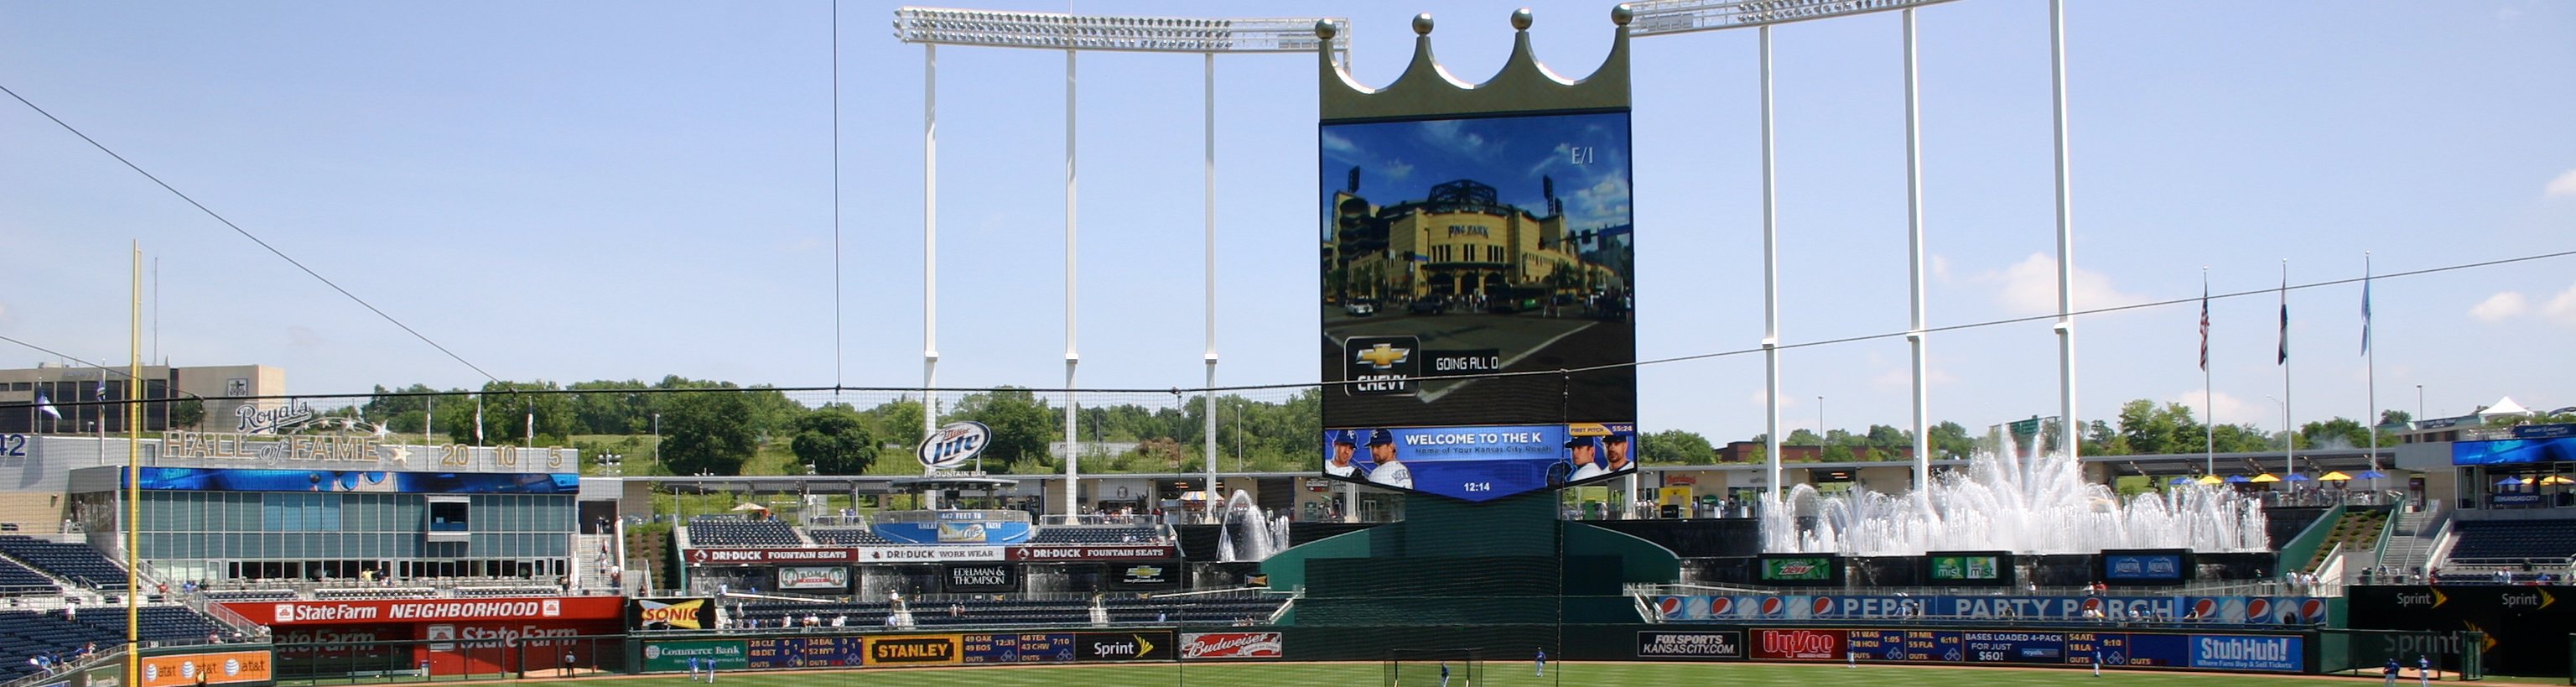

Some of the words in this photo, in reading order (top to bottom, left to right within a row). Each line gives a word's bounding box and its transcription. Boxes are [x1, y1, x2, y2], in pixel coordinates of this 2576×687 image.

[1436, 357, 1467, 371] GOING
[1469, 357, 1488, 370] ALL
[1357, 374, 1407, 392] CHEVY
[235, 398, 310, 434] Royals
[1405, 433, 1476, 445] WELCOME
[1478, 433, 1498, 444] TO
[1501, 432, 1529, 443] THE
[1532, 432, 1542, 443] K
[163, 430, 254, 459] HALL
[259, 437, 288, 466] of
[290, 435, 382, 462] FAME
[932, 434, 980, 465] Lite
[1506, 445, 1522, 454] City
[440, 444, 470, 467] 20
[493, 445, 518, 467] 10
[548, 445, 564, 468] 5
[1463, 482, 1491, 492] 12:14
[767, 551, 816, 559] FOUNTAIN
[818, 551, 847, 559] SEATS
[1087, 549, 1134, 557] FOUNTAIN
[1135, 549, 1164, 557] SEATS
[953, 567, 995, 576] EDELMAN
[995, 566, 1005, 576] &
[953, 575, 1005, 586] THOMPSON
[2397, 592, 2432, 607] Sprint
[2501, 592, 2538, 608] Sprint
[295, 604, 335, 621] State
[336, 603, 377, 620] Farm
[388, 601, 540, 619] NEIGHBORHOOD
[645, 607, 700, 622] SONIC
[1844, 598, 1927, 618] PEPSI
[1955, 598, 2052, 618] PARTY
[460, 625, 519, 649] State
[522, 624, 578, 648] Farm
[995, 638, 1016, 647] 12:35
[1994, 633, 2029, 642] LOADED
[2080, 633, 2096, 642] ATL
[661, 646, 714, 656] Commerce
[715, 645, 740, 655] Bank
[878, 643, 949, 658] STANLEY
[1093, 642, 1135, 658] Sprint
[1183, 633, 1269, 658] Budweiser
[1991, 643, 2012, 651] JUST
[2201, 637, 2289, 662] StubHub!
[2383, 630, 2461, 658] Sprint
[1978, 650, 2004, 661] $60!
[158, 665, 177, 677] at&t
[241, 659, 266, 672] at&t
[2235, 660, 2248, 669] Buy
